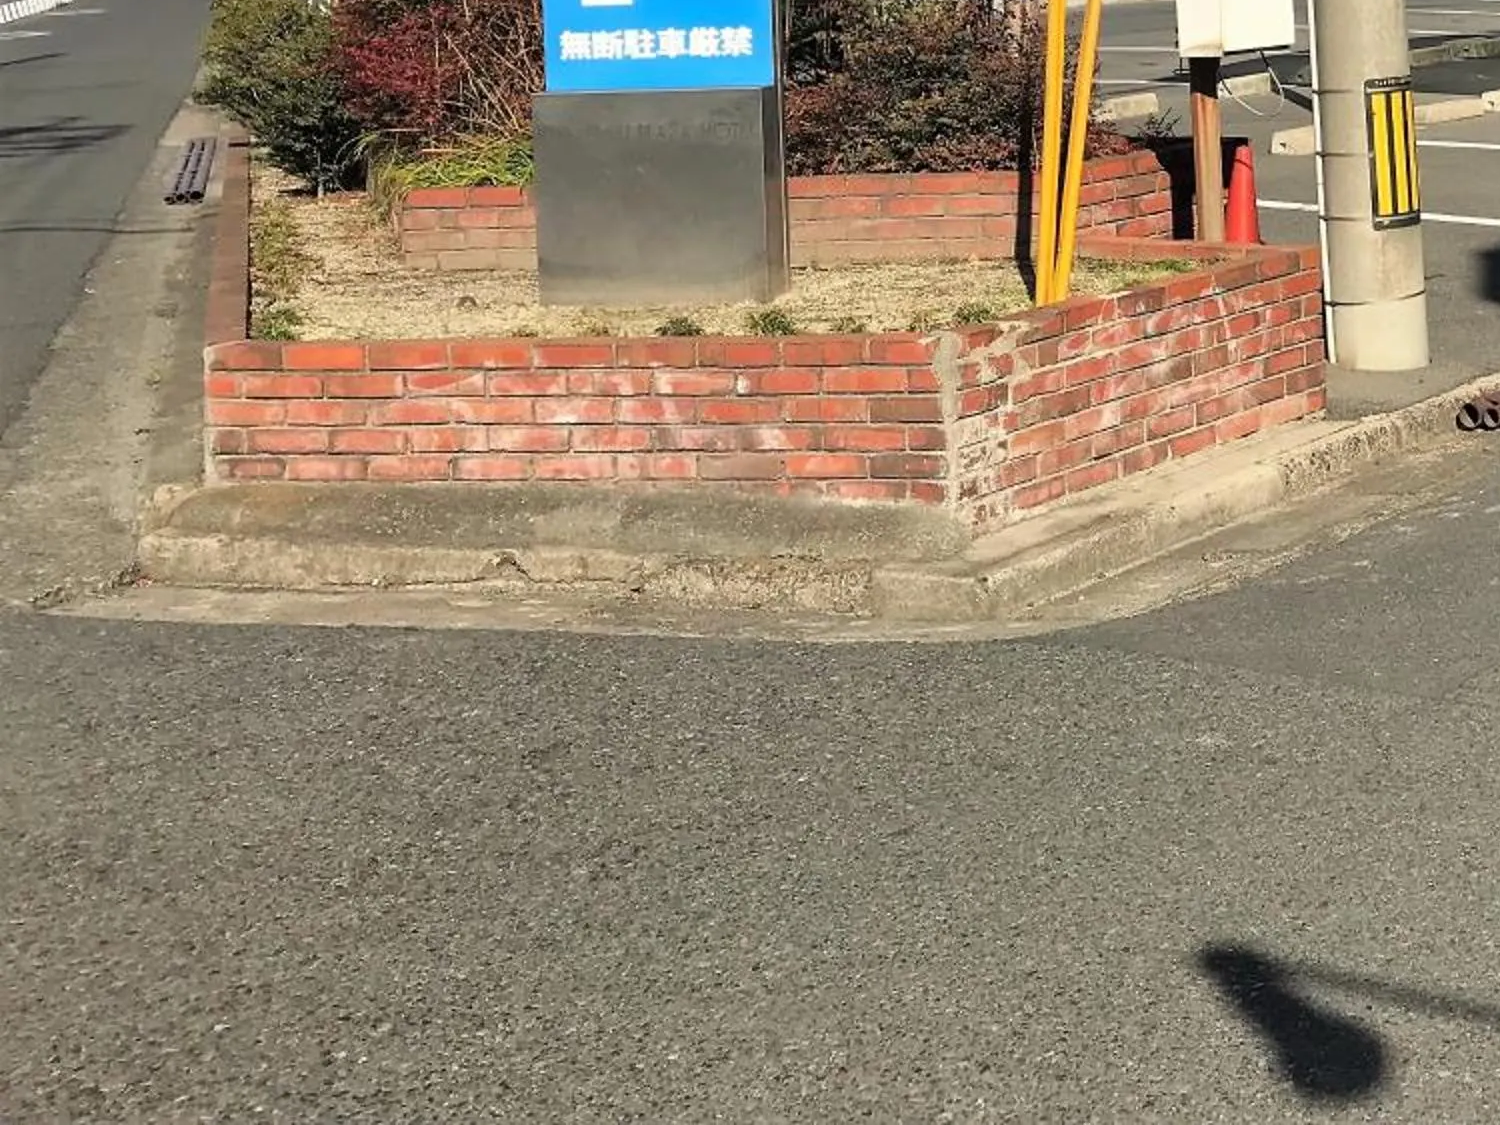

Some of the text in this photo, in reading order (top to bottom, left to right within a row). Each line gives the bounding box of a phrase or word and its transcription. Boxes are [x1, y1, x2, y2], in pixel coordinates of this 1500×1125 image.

[559, 26, 753, 61] 無断駐車厳禁
